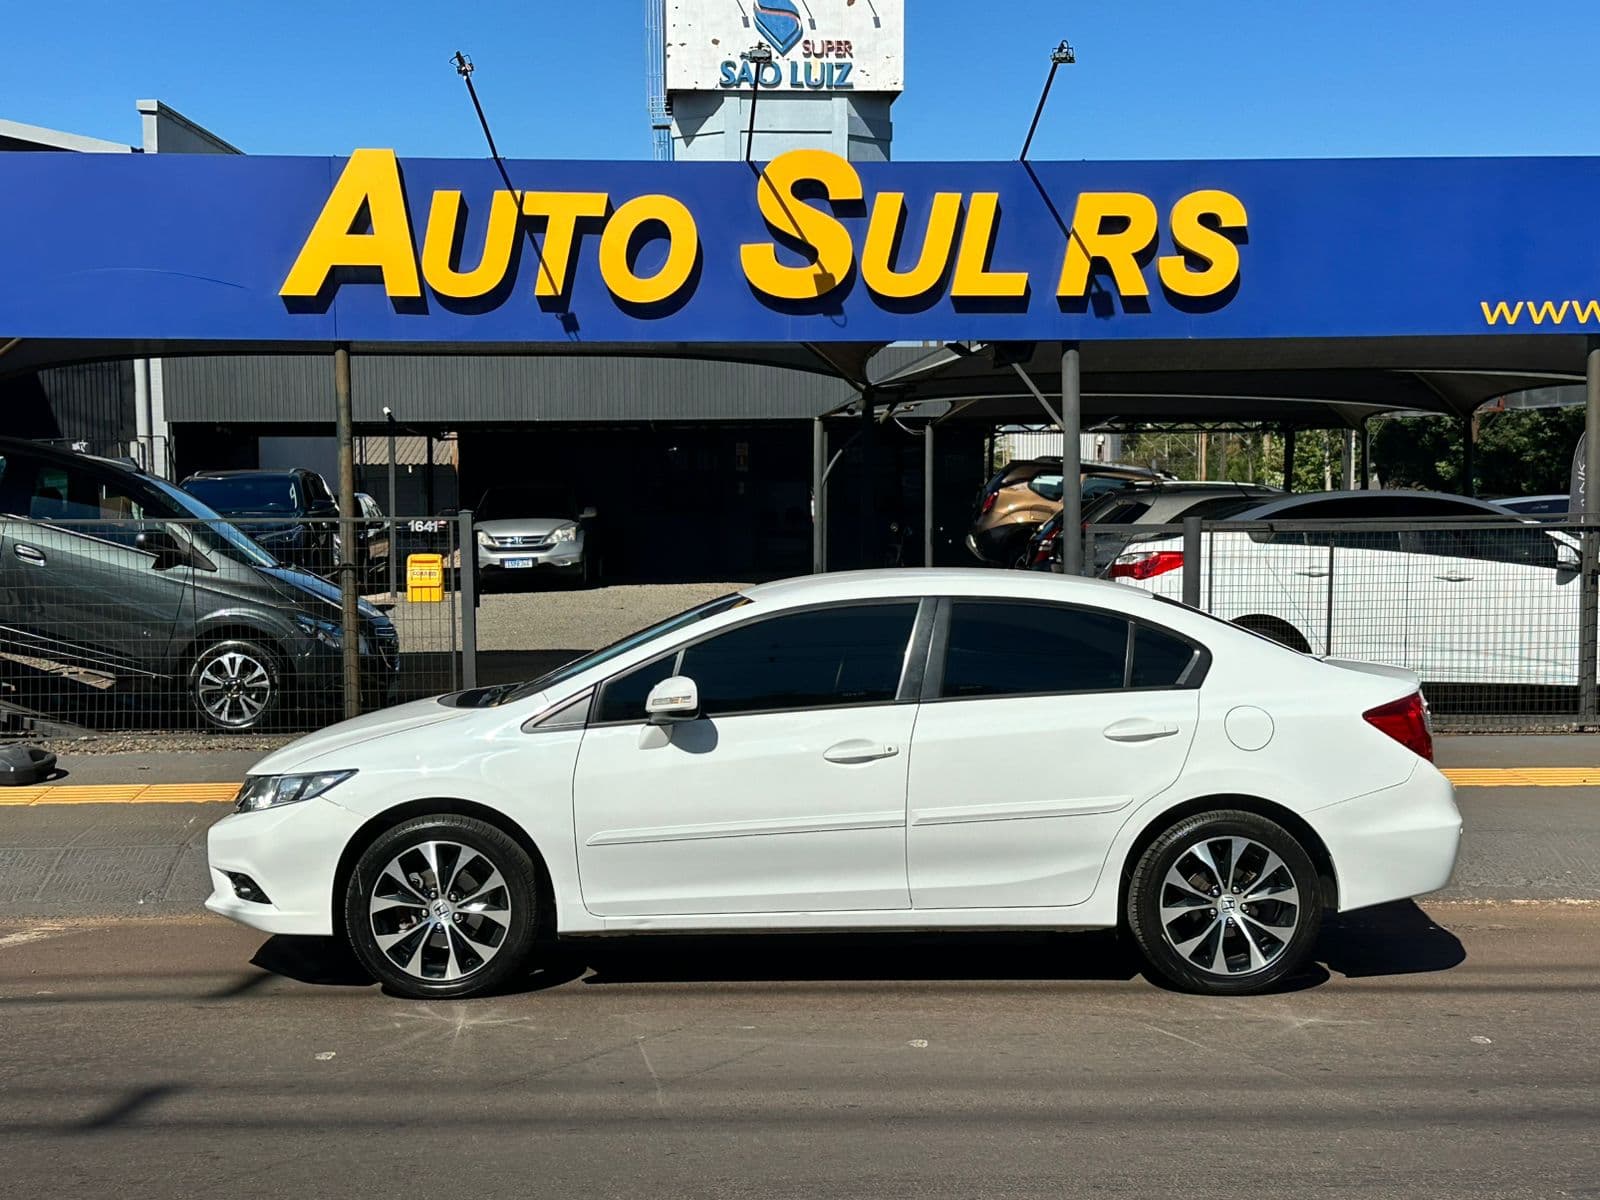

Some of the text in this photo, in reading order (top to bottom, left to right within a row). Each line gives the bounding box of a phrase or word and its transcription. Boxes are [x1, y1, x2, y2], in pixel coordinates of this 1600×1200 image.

[802, 39, 854, 59] SUPER
[790, 60, 854, 90] LUIZ
[279, 148, 1249, 304] AUTO SUL RS
[407, 519, 438, 533] 1641
